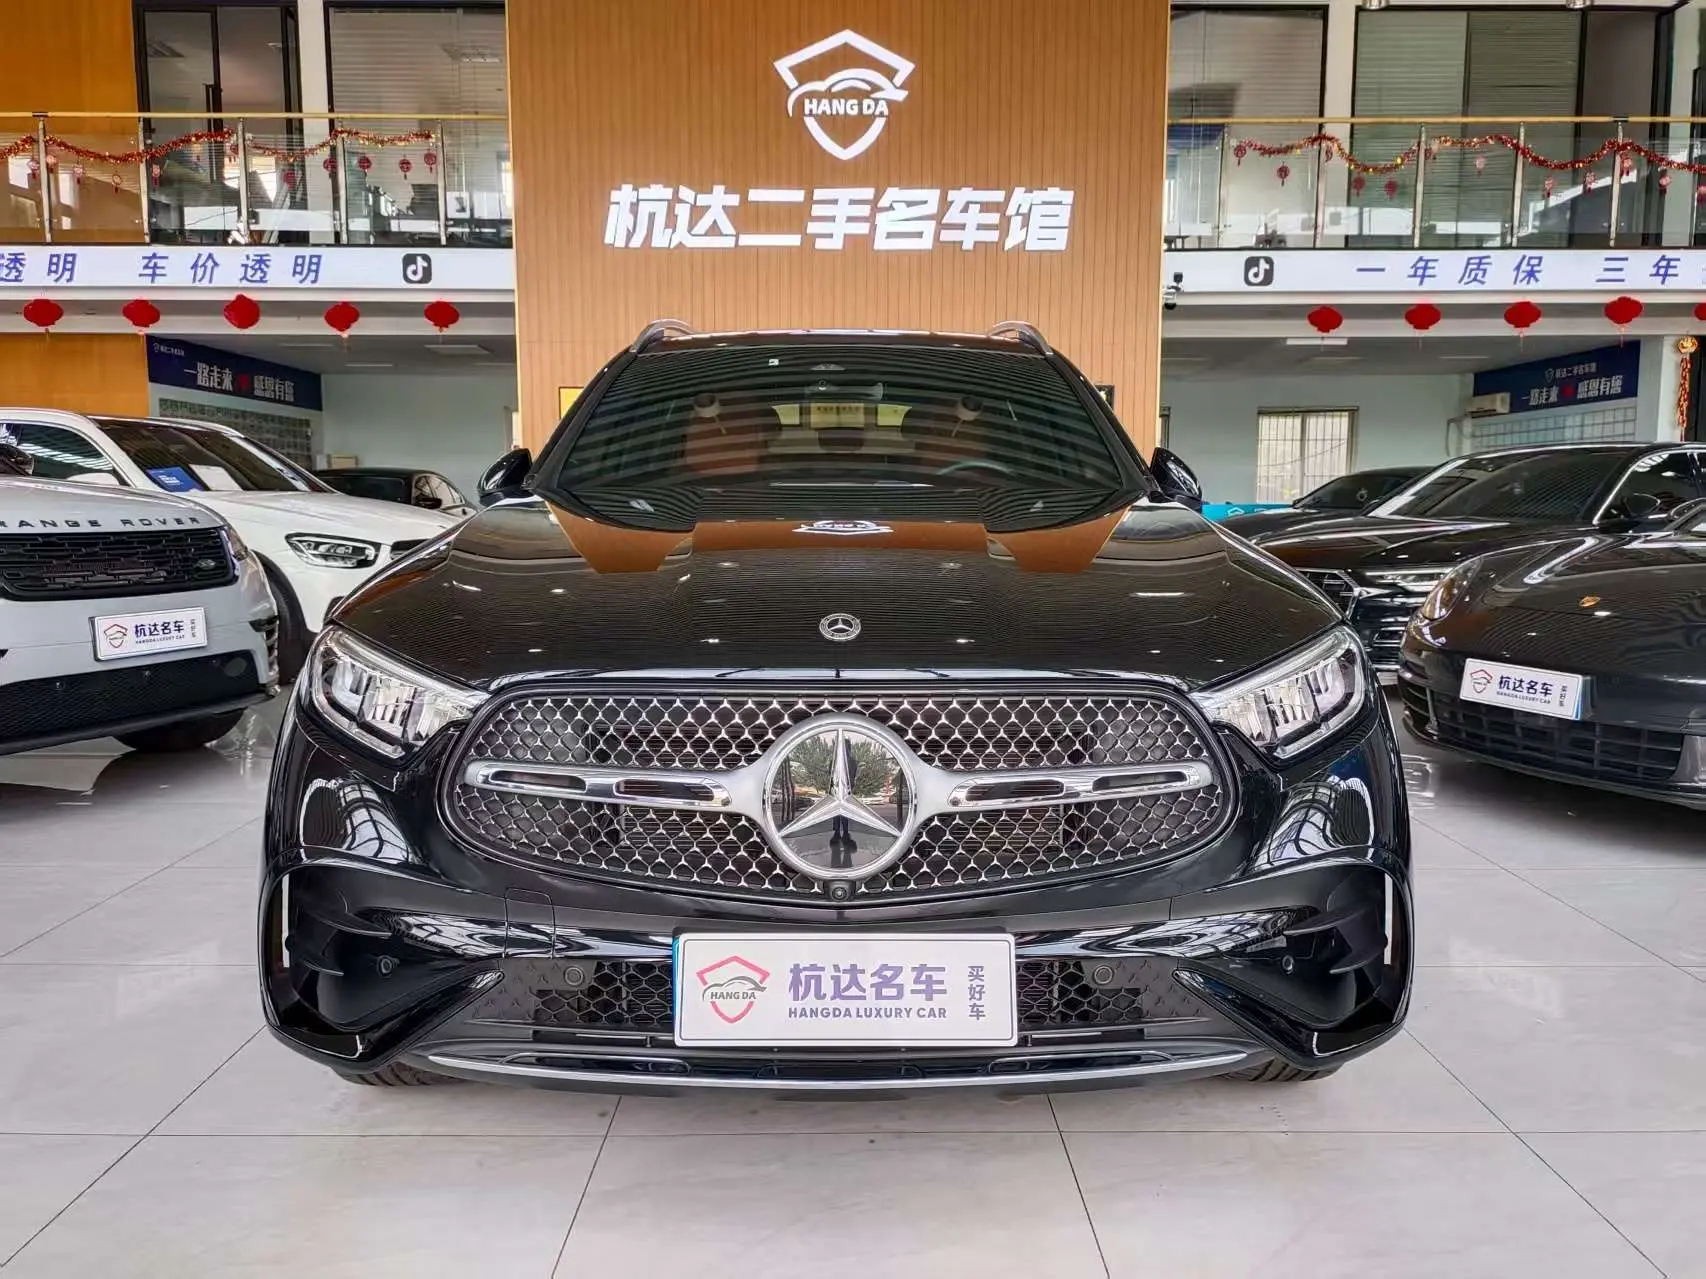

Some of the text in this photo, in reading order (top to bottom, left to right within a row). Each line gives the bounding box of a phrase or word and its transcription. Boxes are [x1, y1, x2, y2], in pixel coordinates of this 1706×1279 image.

[804, 98, 889, 116] HANG DA
[603, 184, 1075, 252] 杭达二手名车馆
[0, 252, 323, 285] 透明 车价透明
[1356, 254, 1706, 286] 一年质保 三年
[183, 361, 234, 392] 一路走来
[119, 516, 201, 528] ROVER
[134, 620, 185, 638] 杭达名车
[1498, 674, 1554, 697] 杭达名车
[710, 991, 757, 1000] HANG DA
[788, 963, 948, 1001] 杭达名车
[967, 965, 986, 1021] 买好车
[788, 1007, 947, 1019] HANGDA LUXURY CAR
